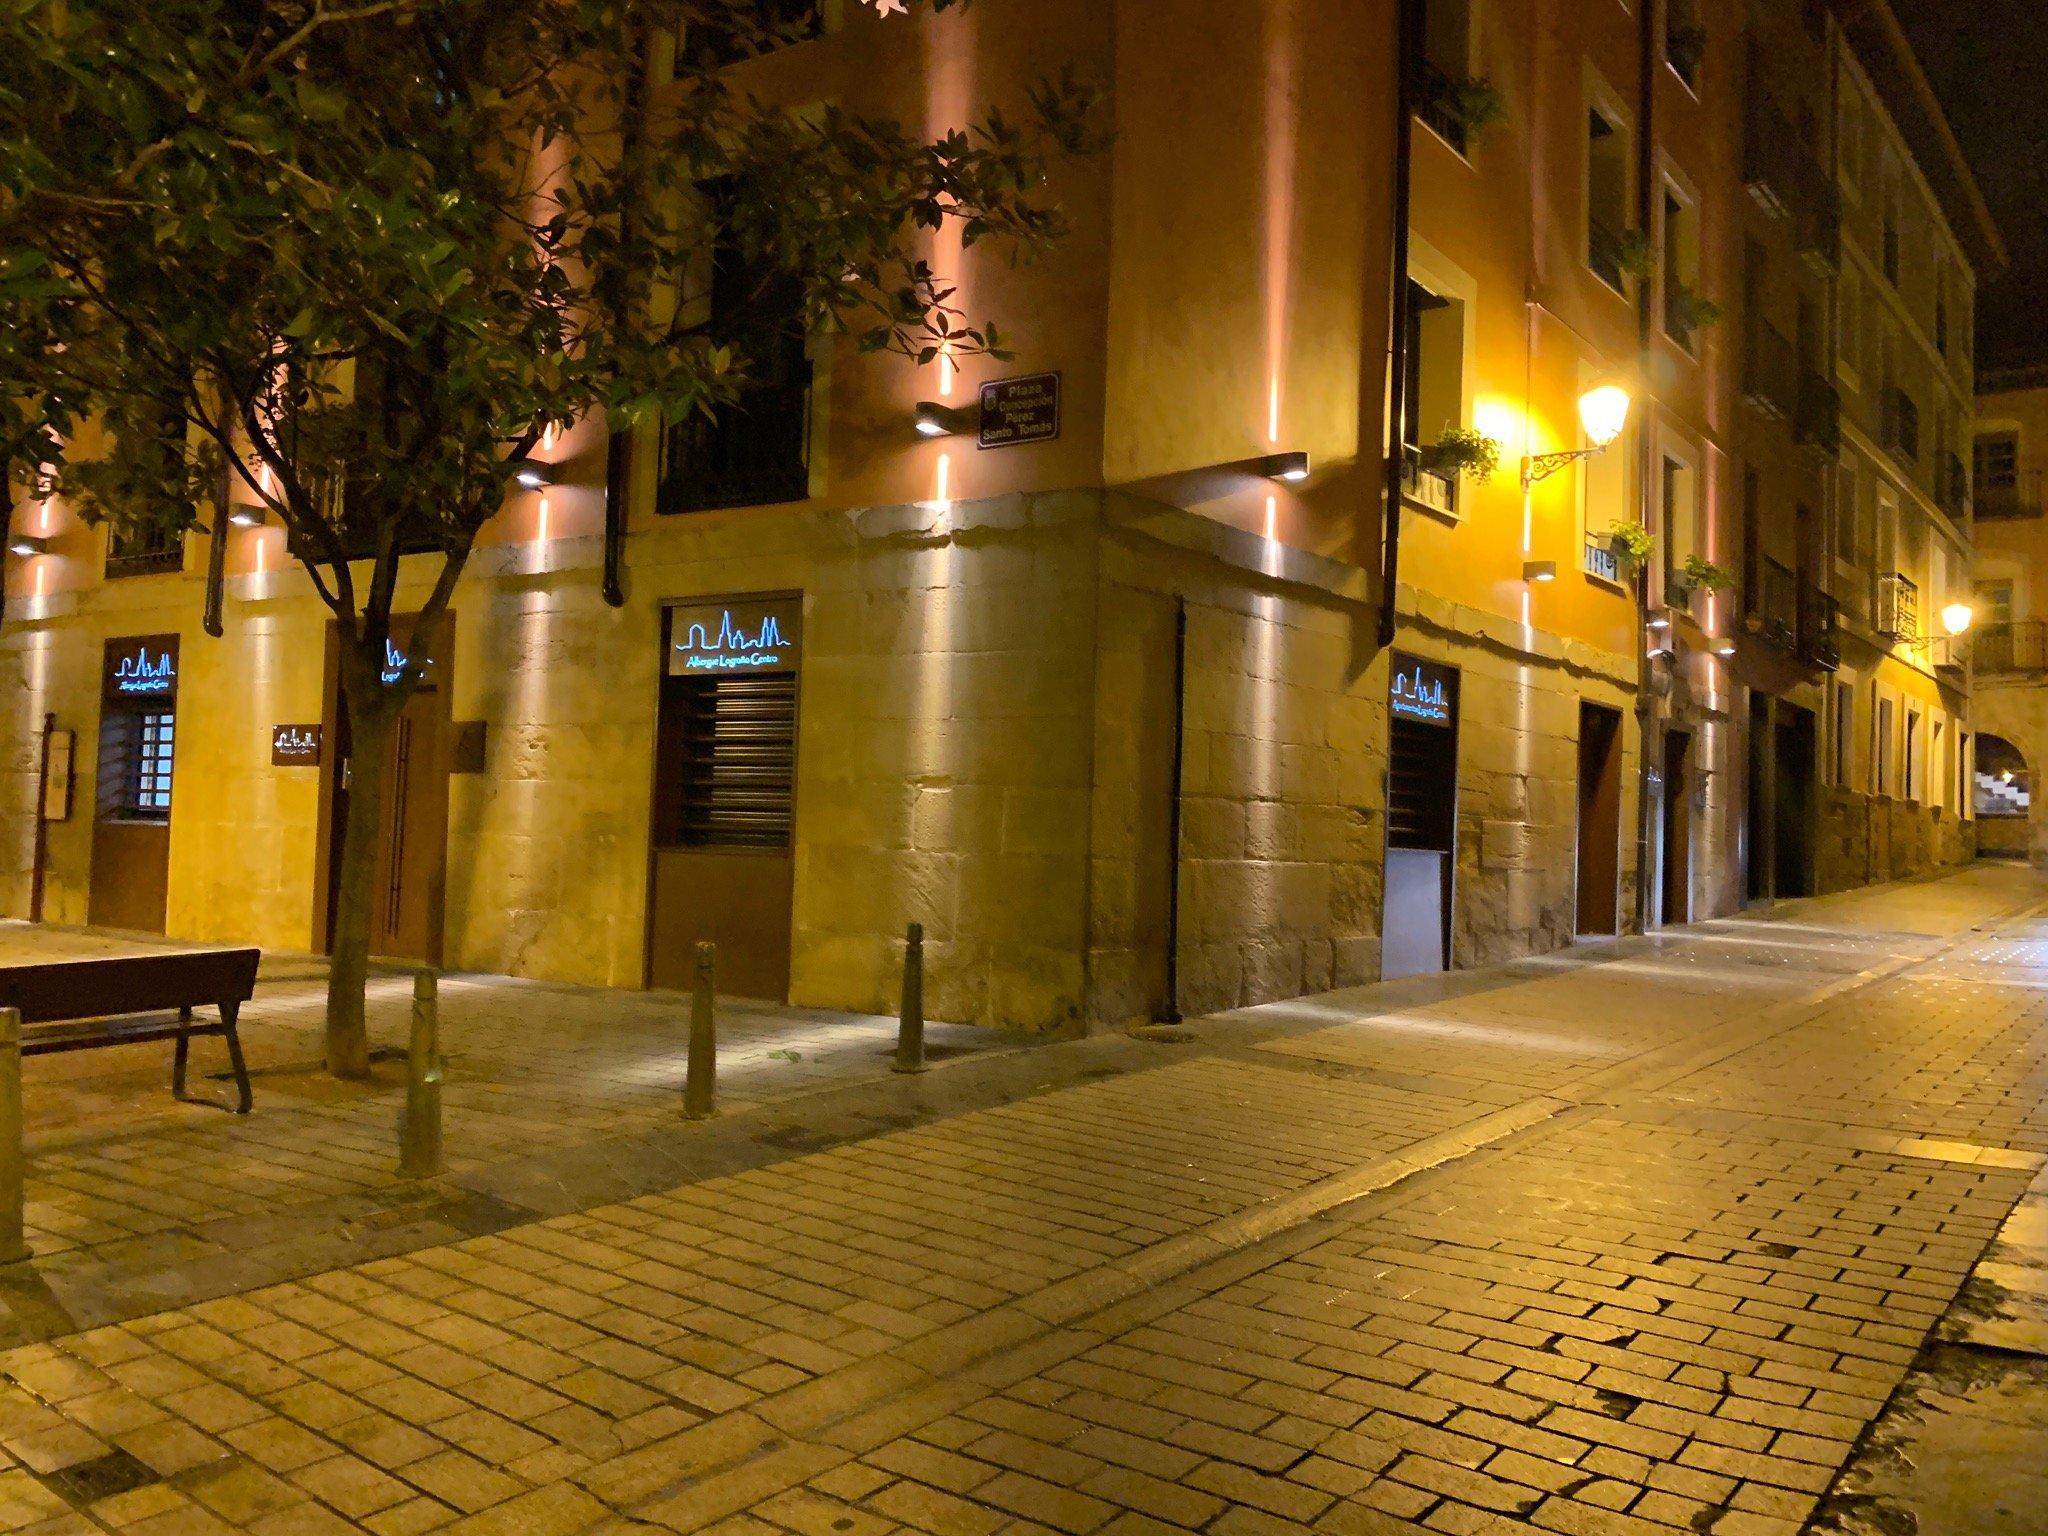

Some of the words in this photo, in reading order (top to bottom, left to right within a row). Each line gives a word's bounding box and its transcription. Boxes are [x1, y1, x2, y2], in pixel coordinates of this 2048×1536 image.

[1008, 384, 1043, 397] Plaza
[686, 656, 719, 669] Albergue
[719, 654, 751, 668] Logroño
[751, 652, 778, 666] Centro
